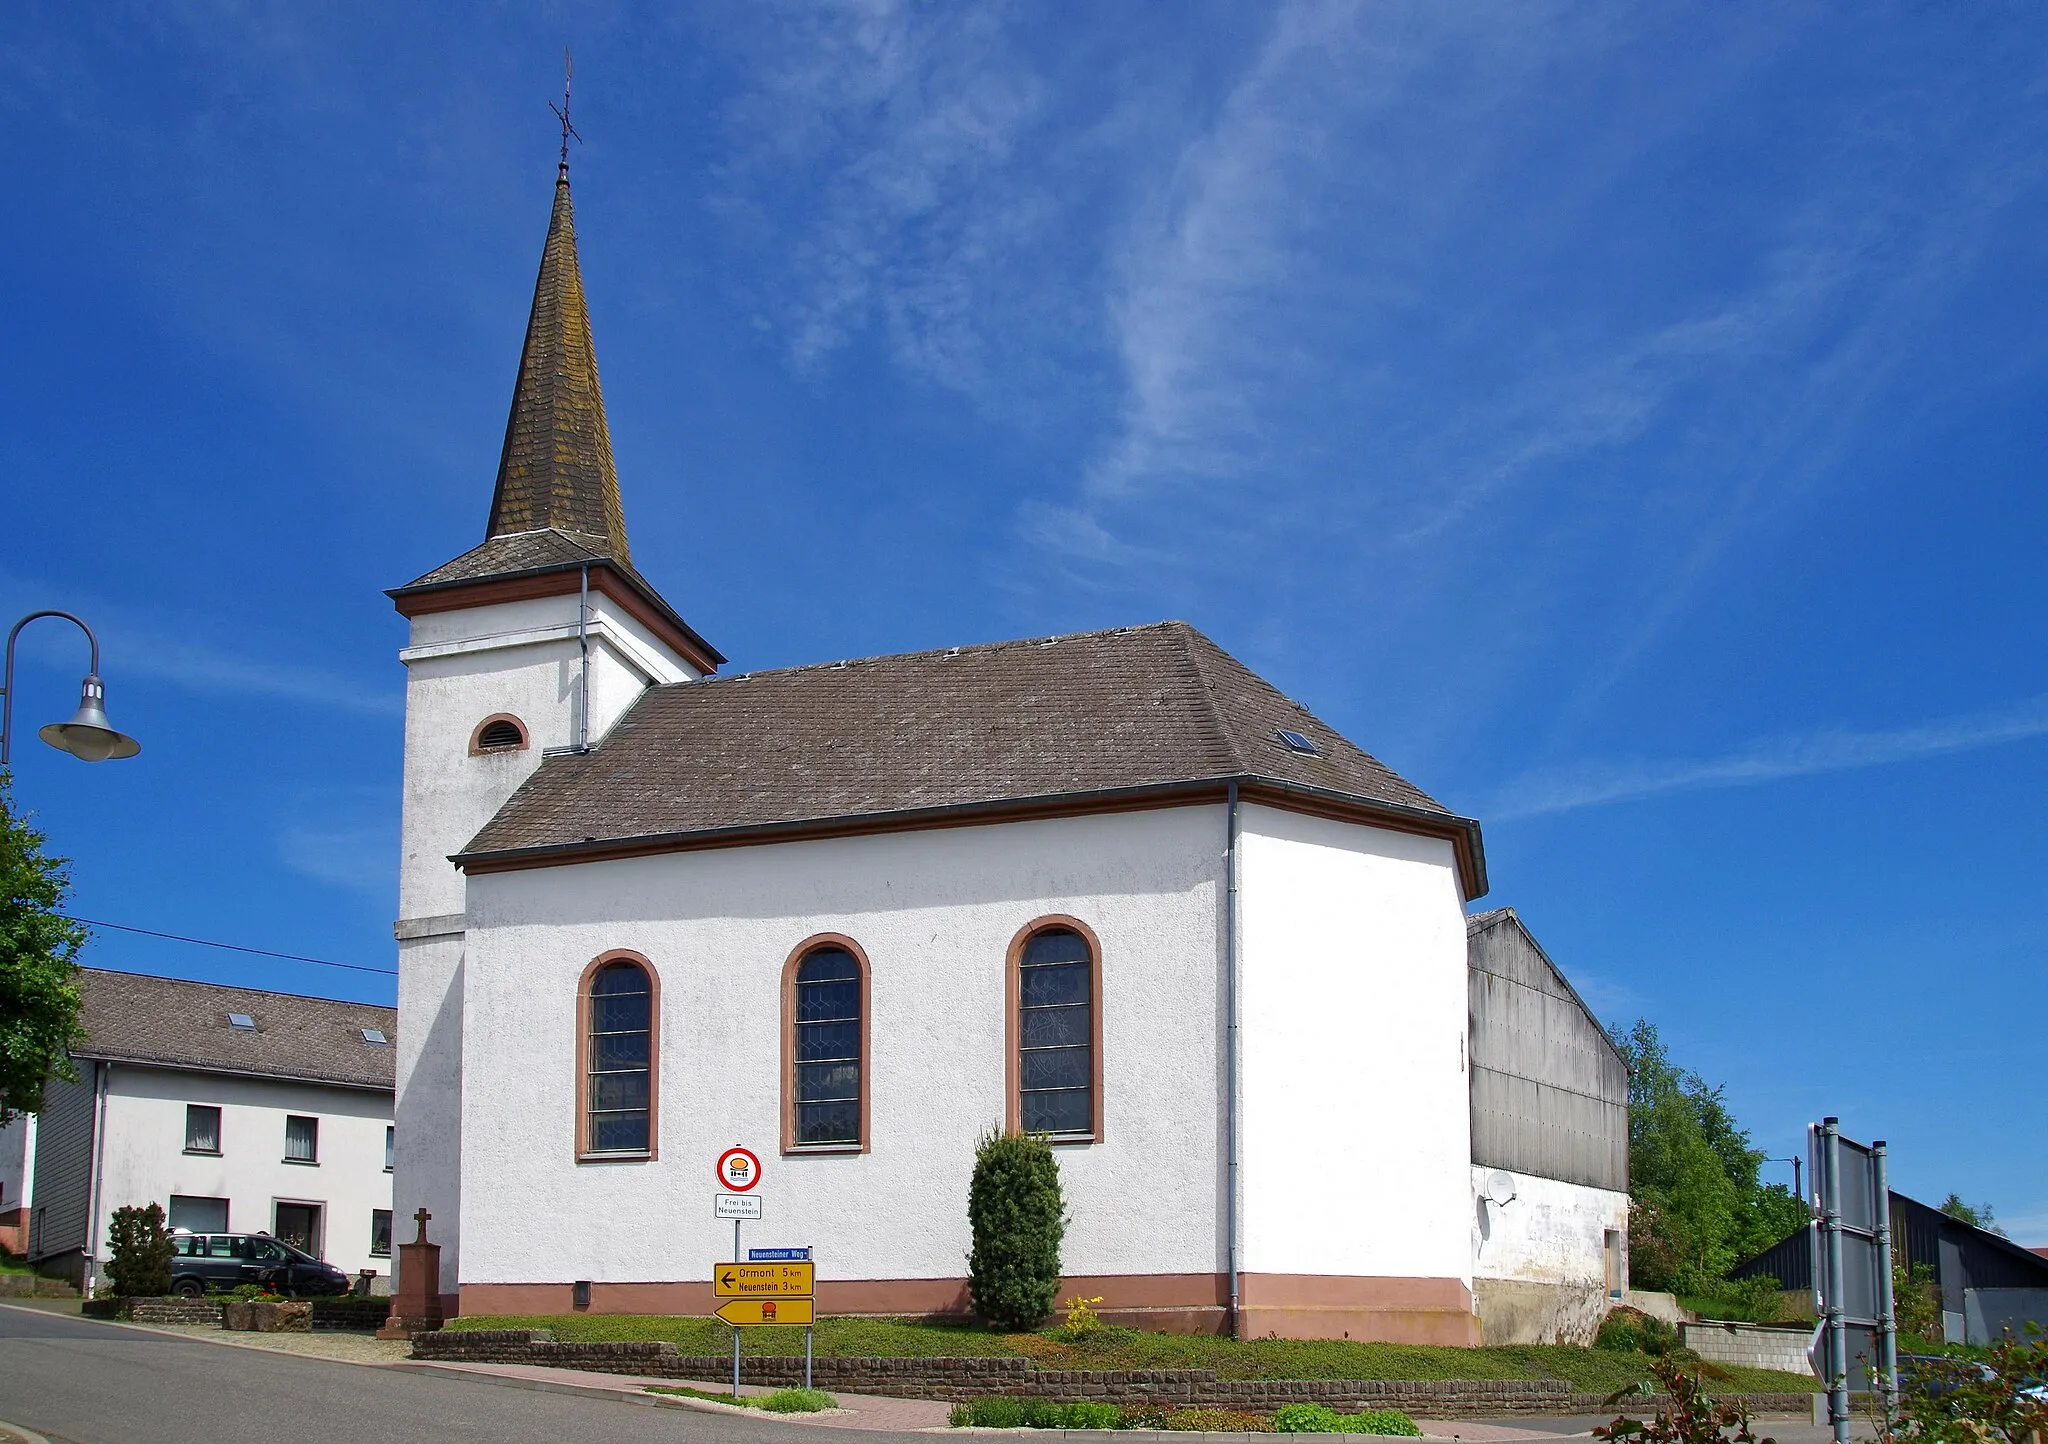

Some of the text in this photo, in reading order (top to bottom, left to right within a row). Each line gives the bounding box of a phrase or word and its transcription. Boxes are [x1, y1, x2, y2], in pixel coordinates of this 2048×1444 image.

[752, 1250, 804, 1259] Neuensteiner Weg
[740, 1268, 774, 1277] Ormont
[782, 1268, 788, 1276] 5
[739, 1282, 778, 1291] Neuenstein
[782, 1282, 788, 1290] 3
